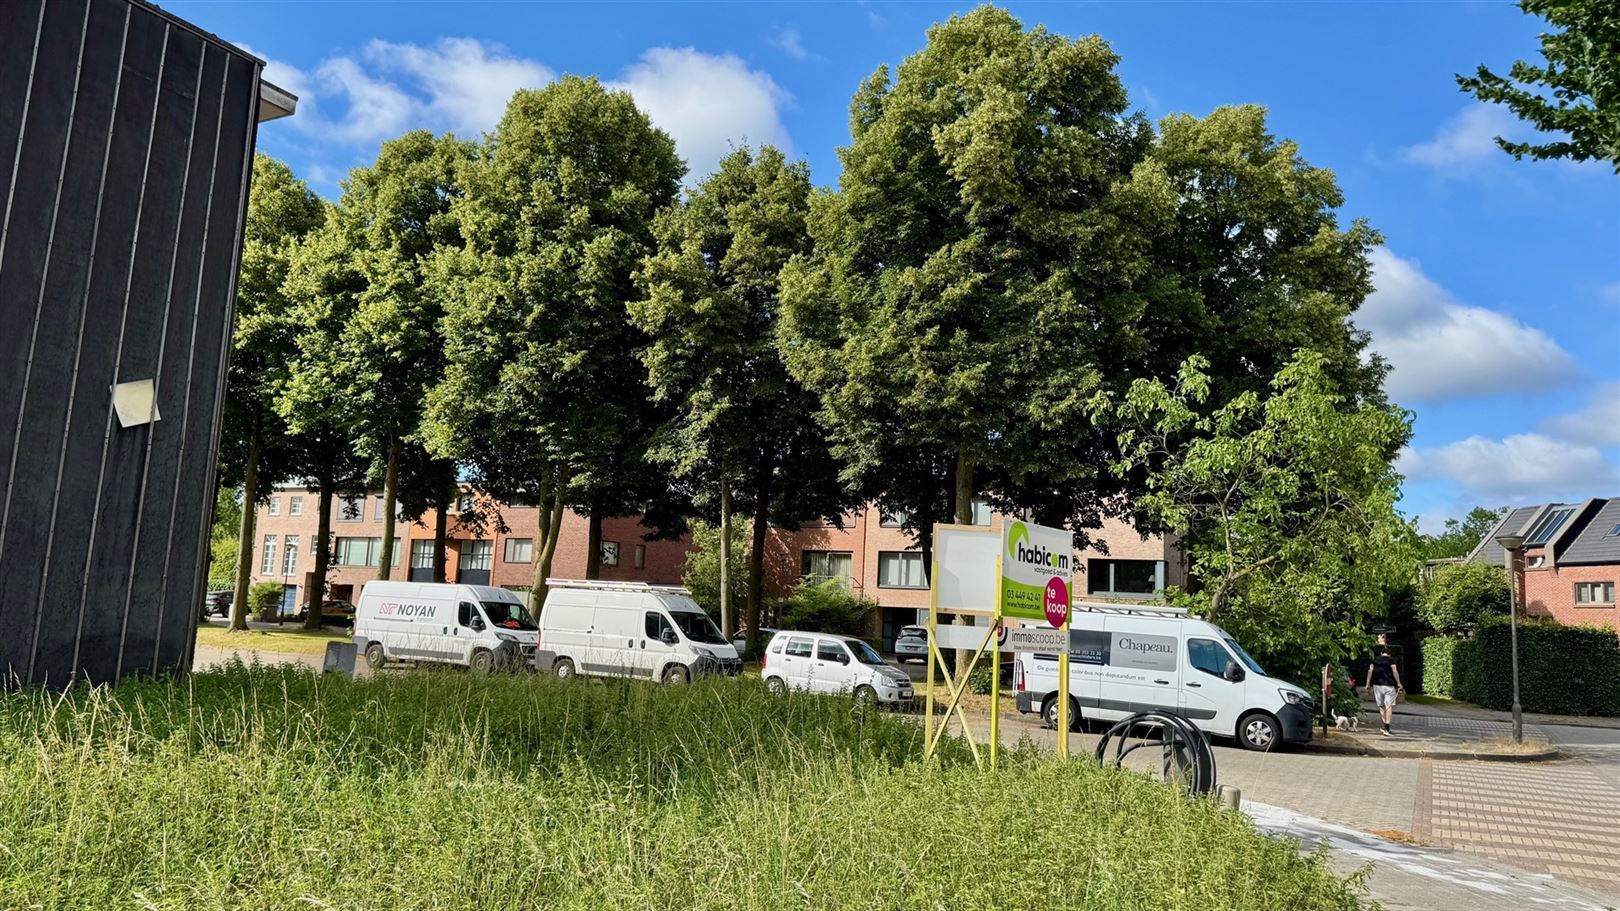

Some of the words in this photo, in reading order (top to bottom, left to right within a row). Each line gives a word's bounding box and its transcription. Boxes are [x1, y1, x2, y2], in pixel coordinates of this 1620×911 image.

[1018, 542, 1068, 569] habicom
[1007, 589, 1014, 599] 03
[1015, 590, 1026, 600] 449
[1027, 592, 1034, 602] 42
[1047, 586, 1056, 599] te
[397, 604, 436, 617] NOYAN
[1046, 599, 1067, 618] koop
[1118, 637, 1174, 654] Chapeau.
